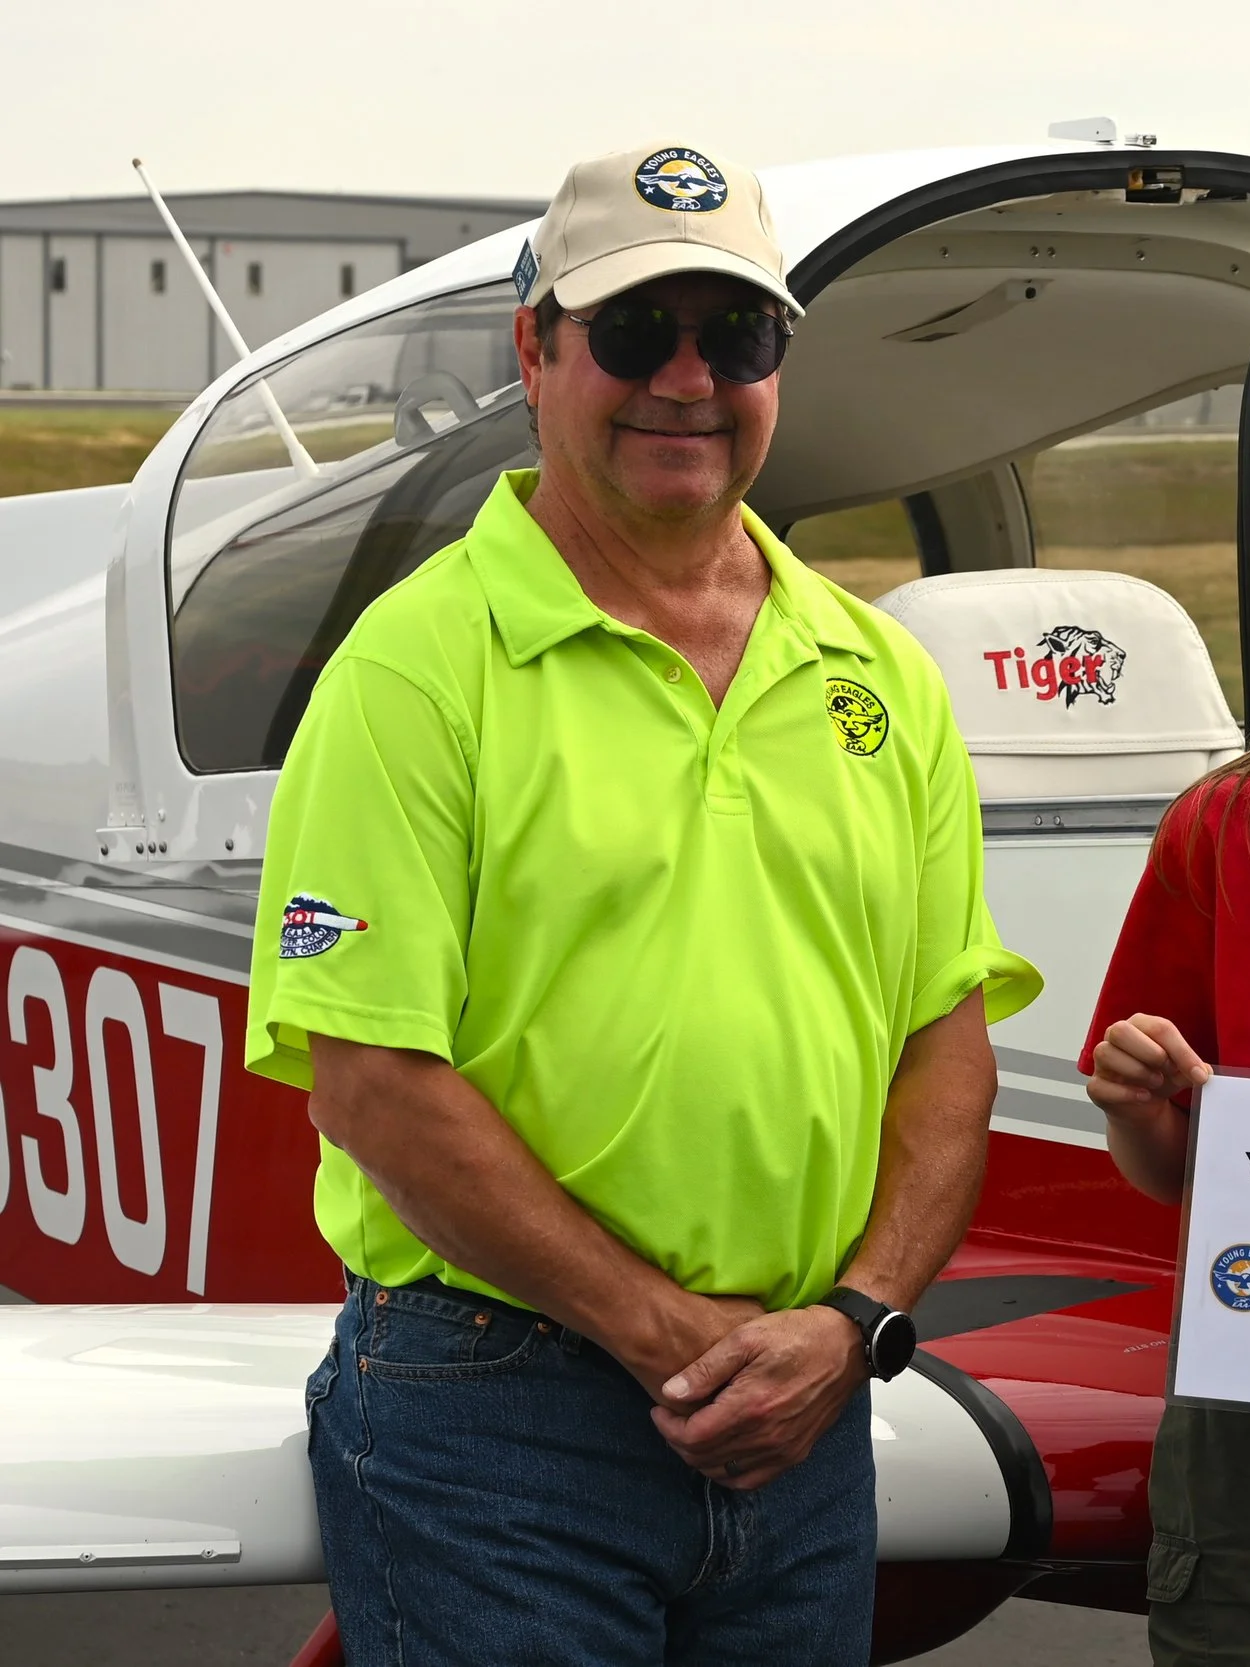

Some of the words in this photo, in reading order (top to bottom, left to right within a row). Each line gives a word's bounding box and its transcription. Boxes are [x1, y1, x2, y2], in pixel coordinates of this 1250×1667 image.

[643, 150, 678, 170] YOUNG
[684, 150, 720, 178] EAGLES
[983, 646, 1106, 701] Tiger
[840, 684, 875, 709] EAGLES
[301, 930, 338, 955] CHAPTER
[0, 945, 223, 1297] 307
[1218, 1249, 1245, 1268] YOUNG
